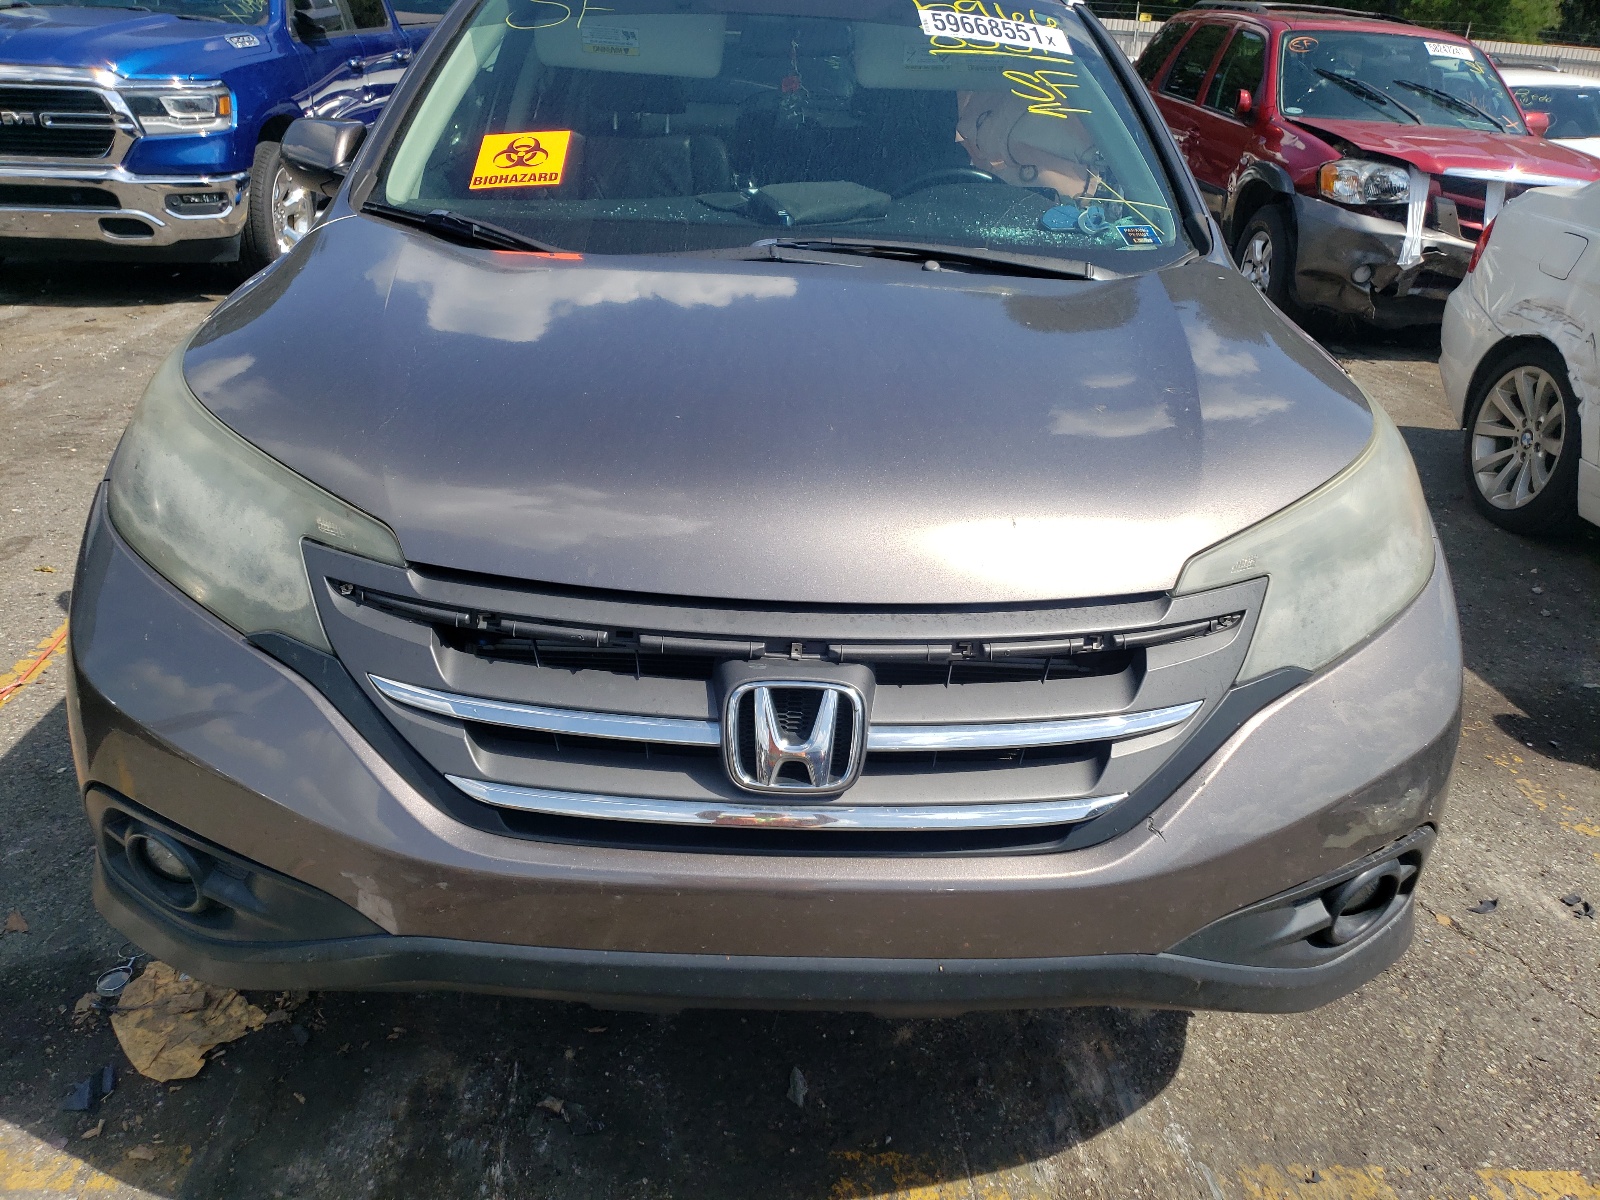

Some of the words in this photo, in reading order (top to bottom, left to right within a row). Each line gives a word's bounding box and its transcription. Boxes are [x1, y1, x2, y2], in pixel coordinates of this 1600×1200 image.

[931, 12, 1043, 44] 59668551
[1002, 70, 1081, 101] SF
[472, 172, 559, 186] BIOHAZARD
